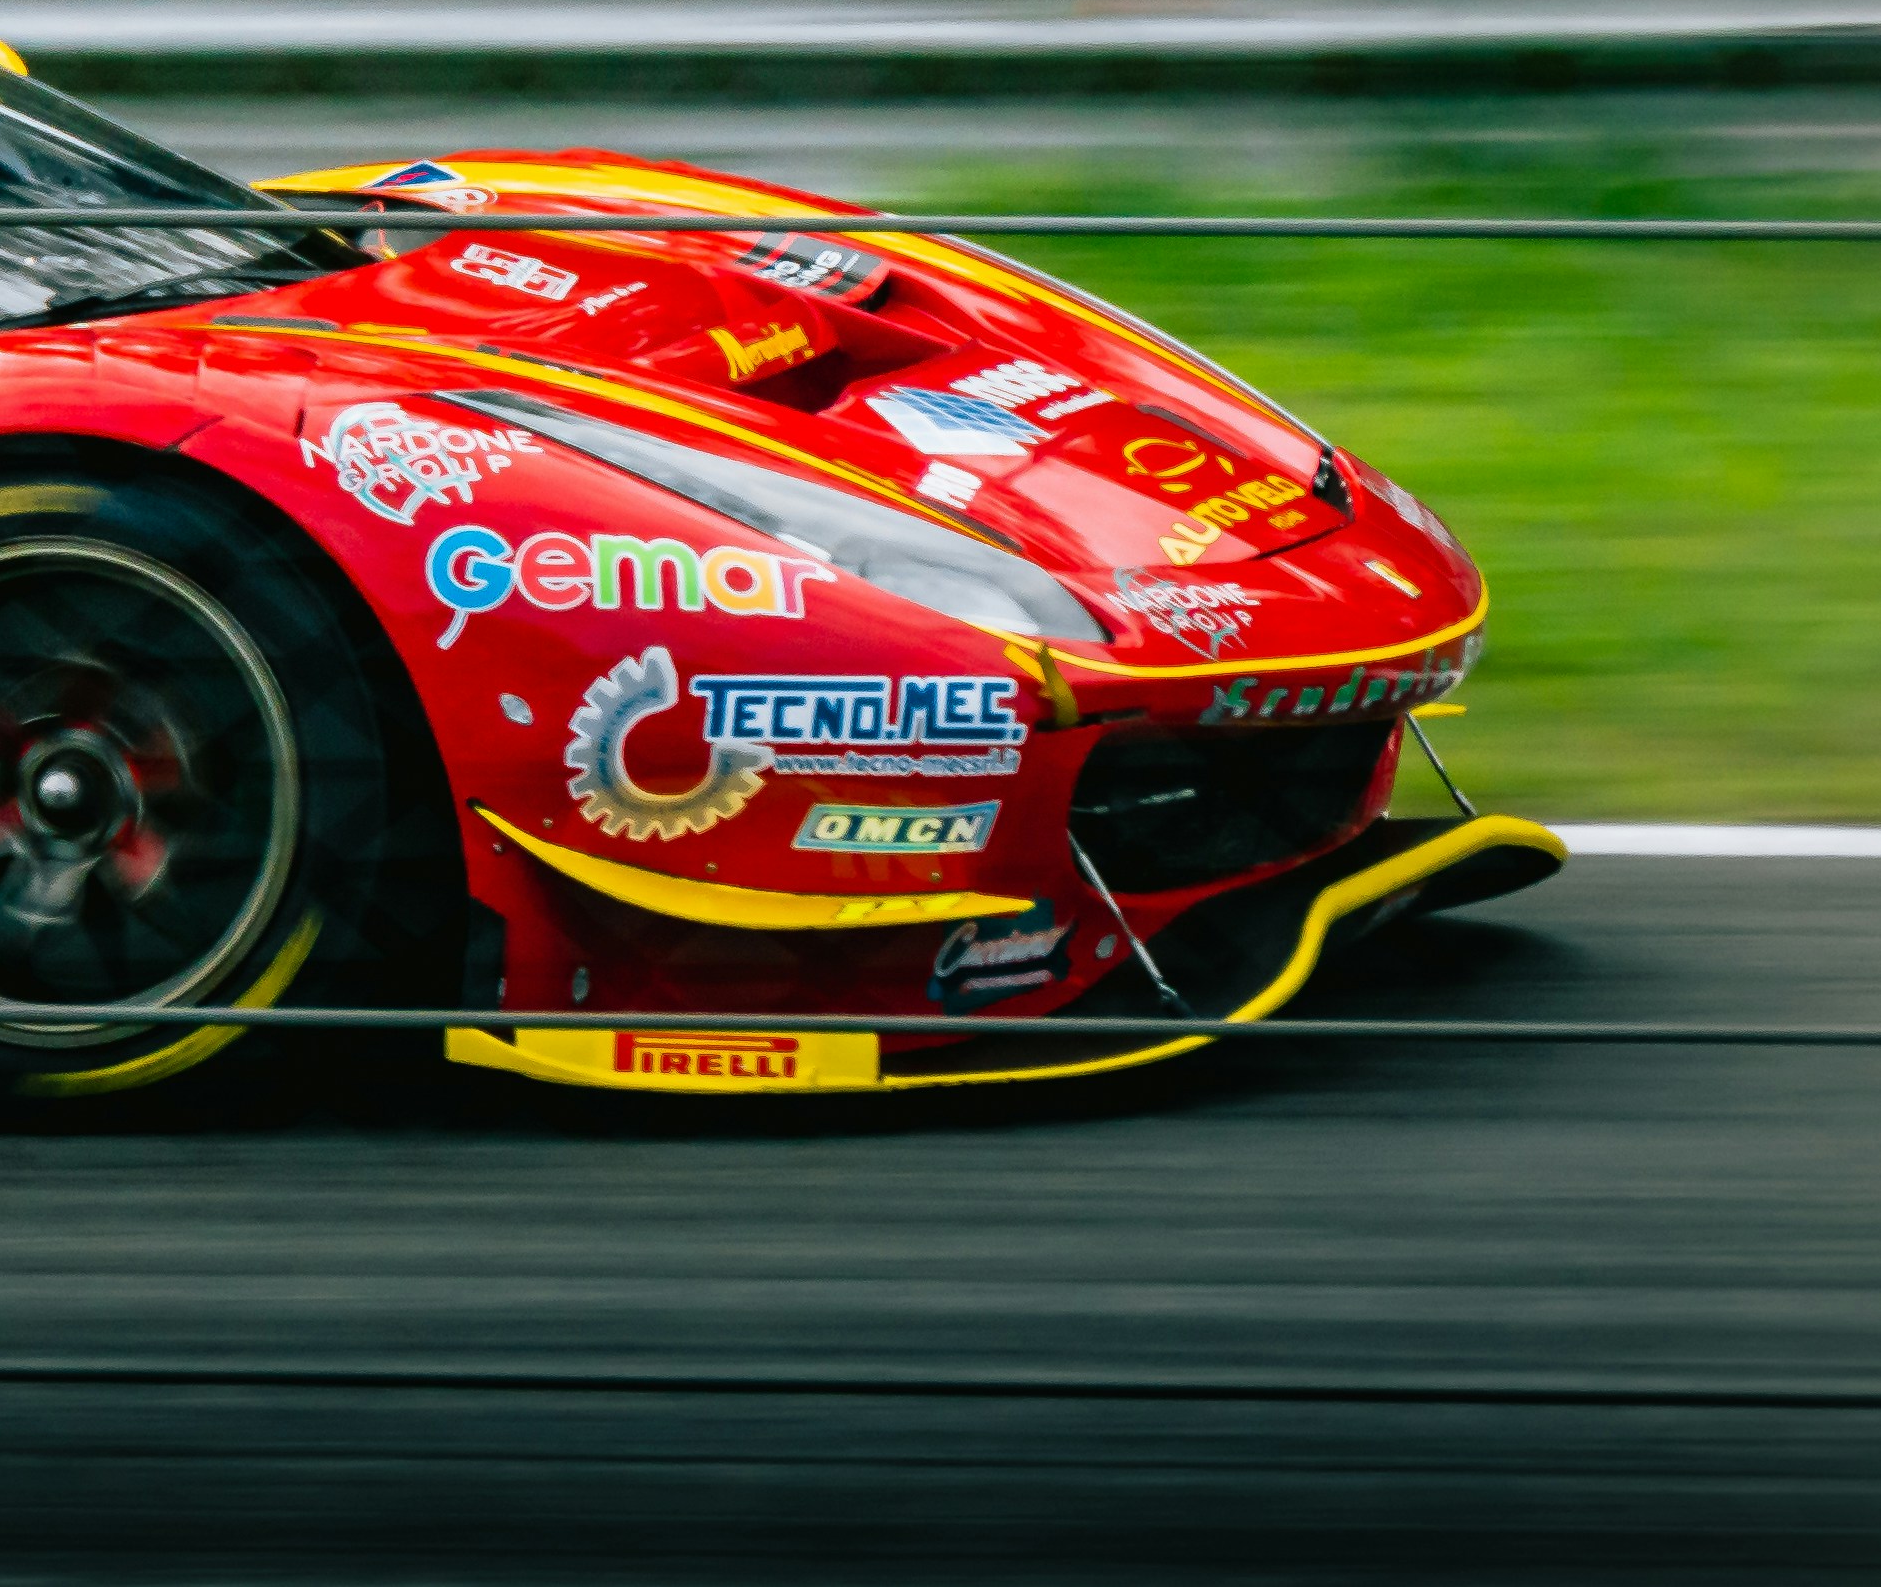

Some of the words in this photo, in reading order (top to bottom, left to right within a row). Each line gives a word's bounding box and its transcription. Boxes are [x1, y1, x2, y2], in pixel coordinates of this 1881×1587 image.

[298, 427, 545, 470] NARDONE
[426, 525, 838, 651] Gemar
[813, 814, 983, 843] OMCN
[614, 1031, 799, 1079] PIRELLI
